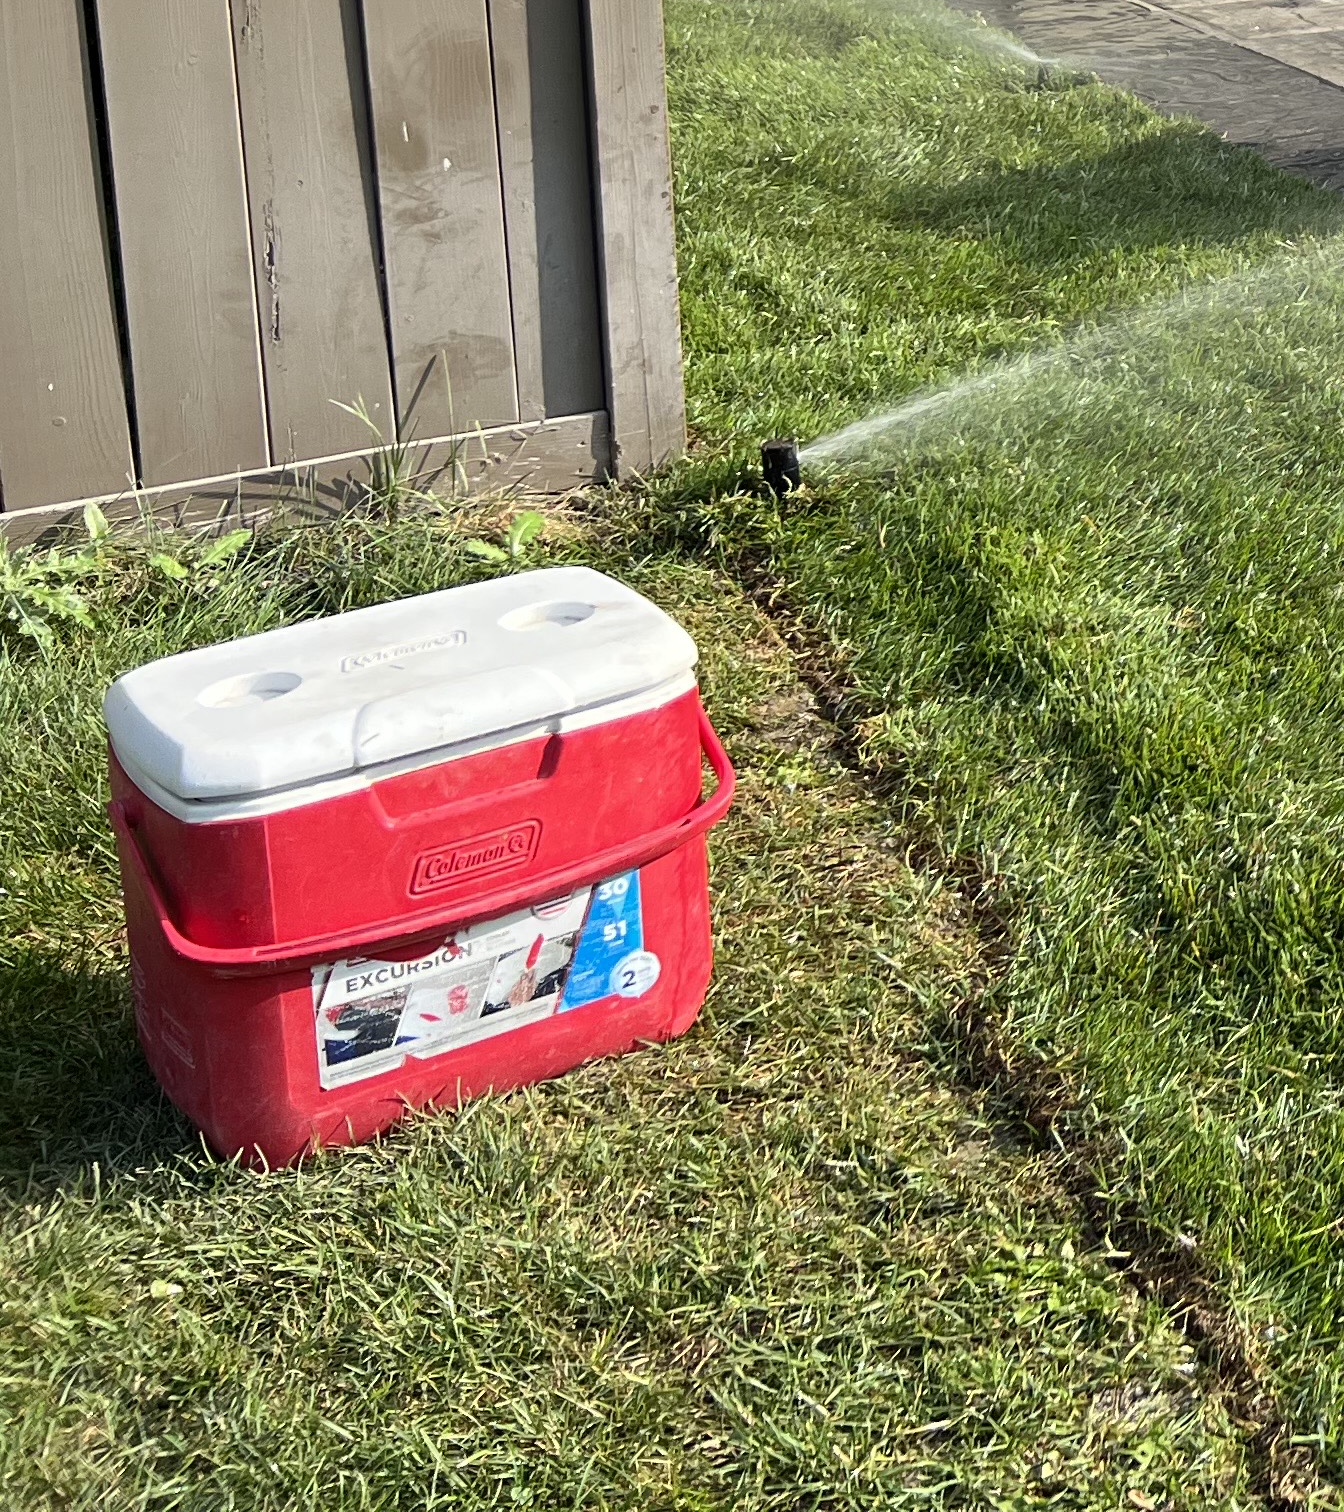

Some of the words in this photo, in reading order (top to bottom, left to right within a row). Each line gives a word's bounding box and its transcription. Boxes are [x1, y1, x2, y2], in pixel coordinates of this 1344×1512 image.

[424, 845, 505, 880] Coleman
[603, 919, 627, 942] 51
[622, 969, 637, 989] 2
